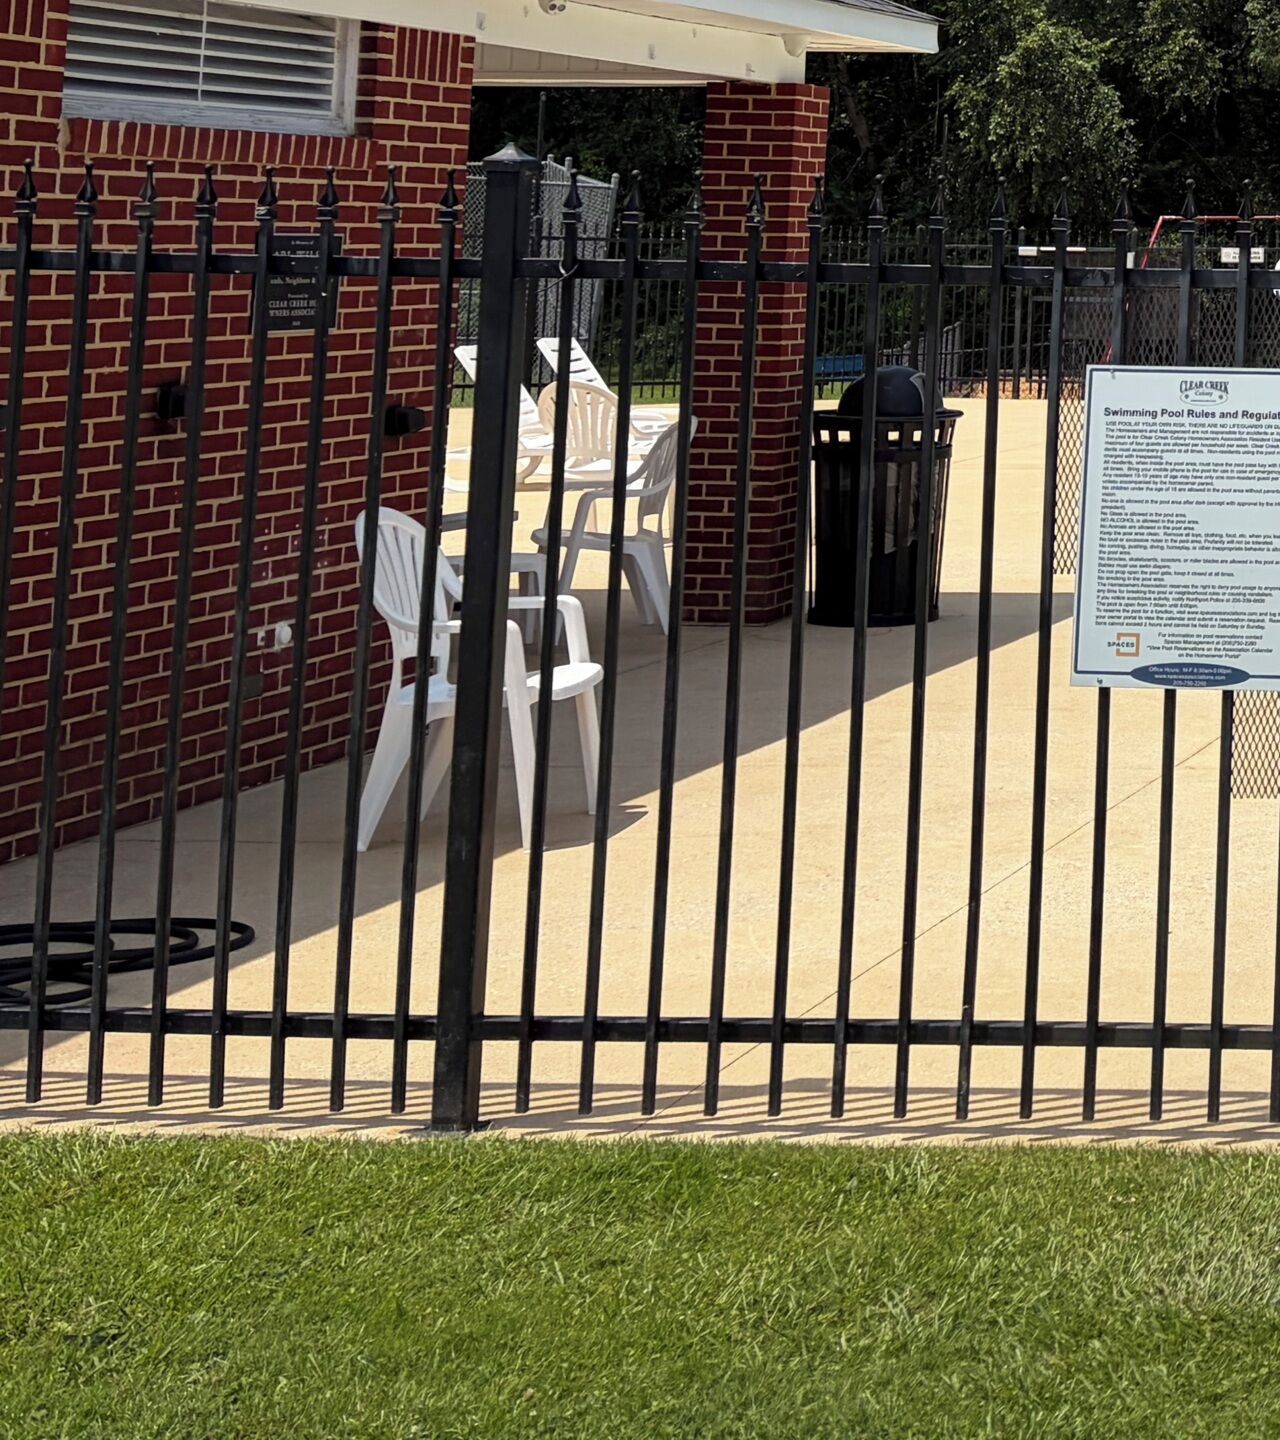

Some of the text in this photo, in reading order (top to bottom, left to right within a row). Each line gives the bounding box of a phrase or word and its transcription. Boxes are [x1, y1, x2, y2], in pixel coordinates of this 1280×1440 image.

[1180, 380, 1229, 394] CLEAR CREEK
[1194, 390, 1213, 398] Colony
[1104, 408, 1158, 420] Swimming
[1161, 409, 1184, 418] Pool
[1188, 410, 1216, 419] Rules
[1219, 410, 1238, 419] and
